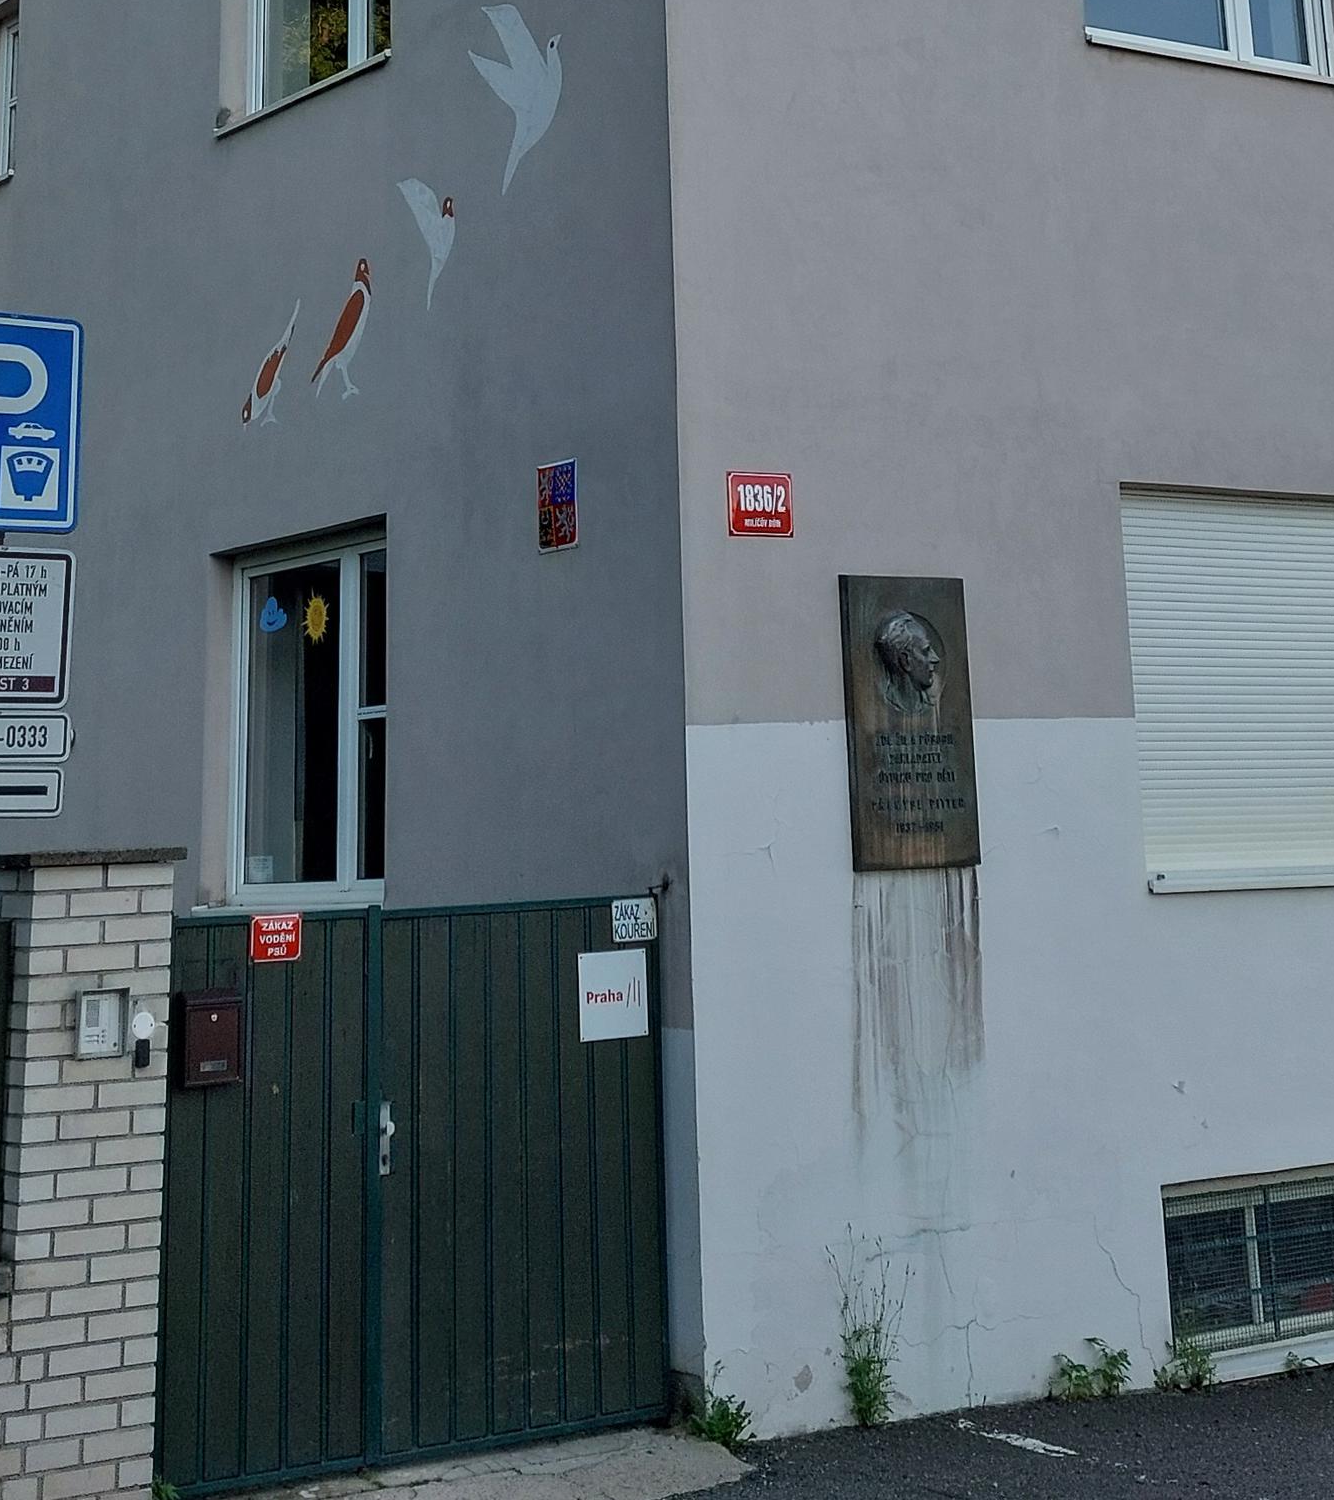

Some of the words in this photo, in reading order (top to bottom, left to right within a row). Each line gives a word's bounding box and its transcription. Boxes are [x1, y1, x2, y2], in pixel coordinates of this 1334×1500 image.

[737, 483, 786, 515] 1836/2
[26, 565, 36, 579] 17
[40, 565, 48, 579] h
[0, 580, 48, 598] PLATNÝM
[13, 637, 21, 652] h
[21, 678, 30, 691] 3
[614, 902, 641, 921] ZÁKAZ
[261, 920, 295, 931] ZÁKAZ
[614, 918, 655, 939] KOUŘENÍ
[259, 931, 296, 945] VODĚNÍ
[586, 989, 624, 1004] Praha
